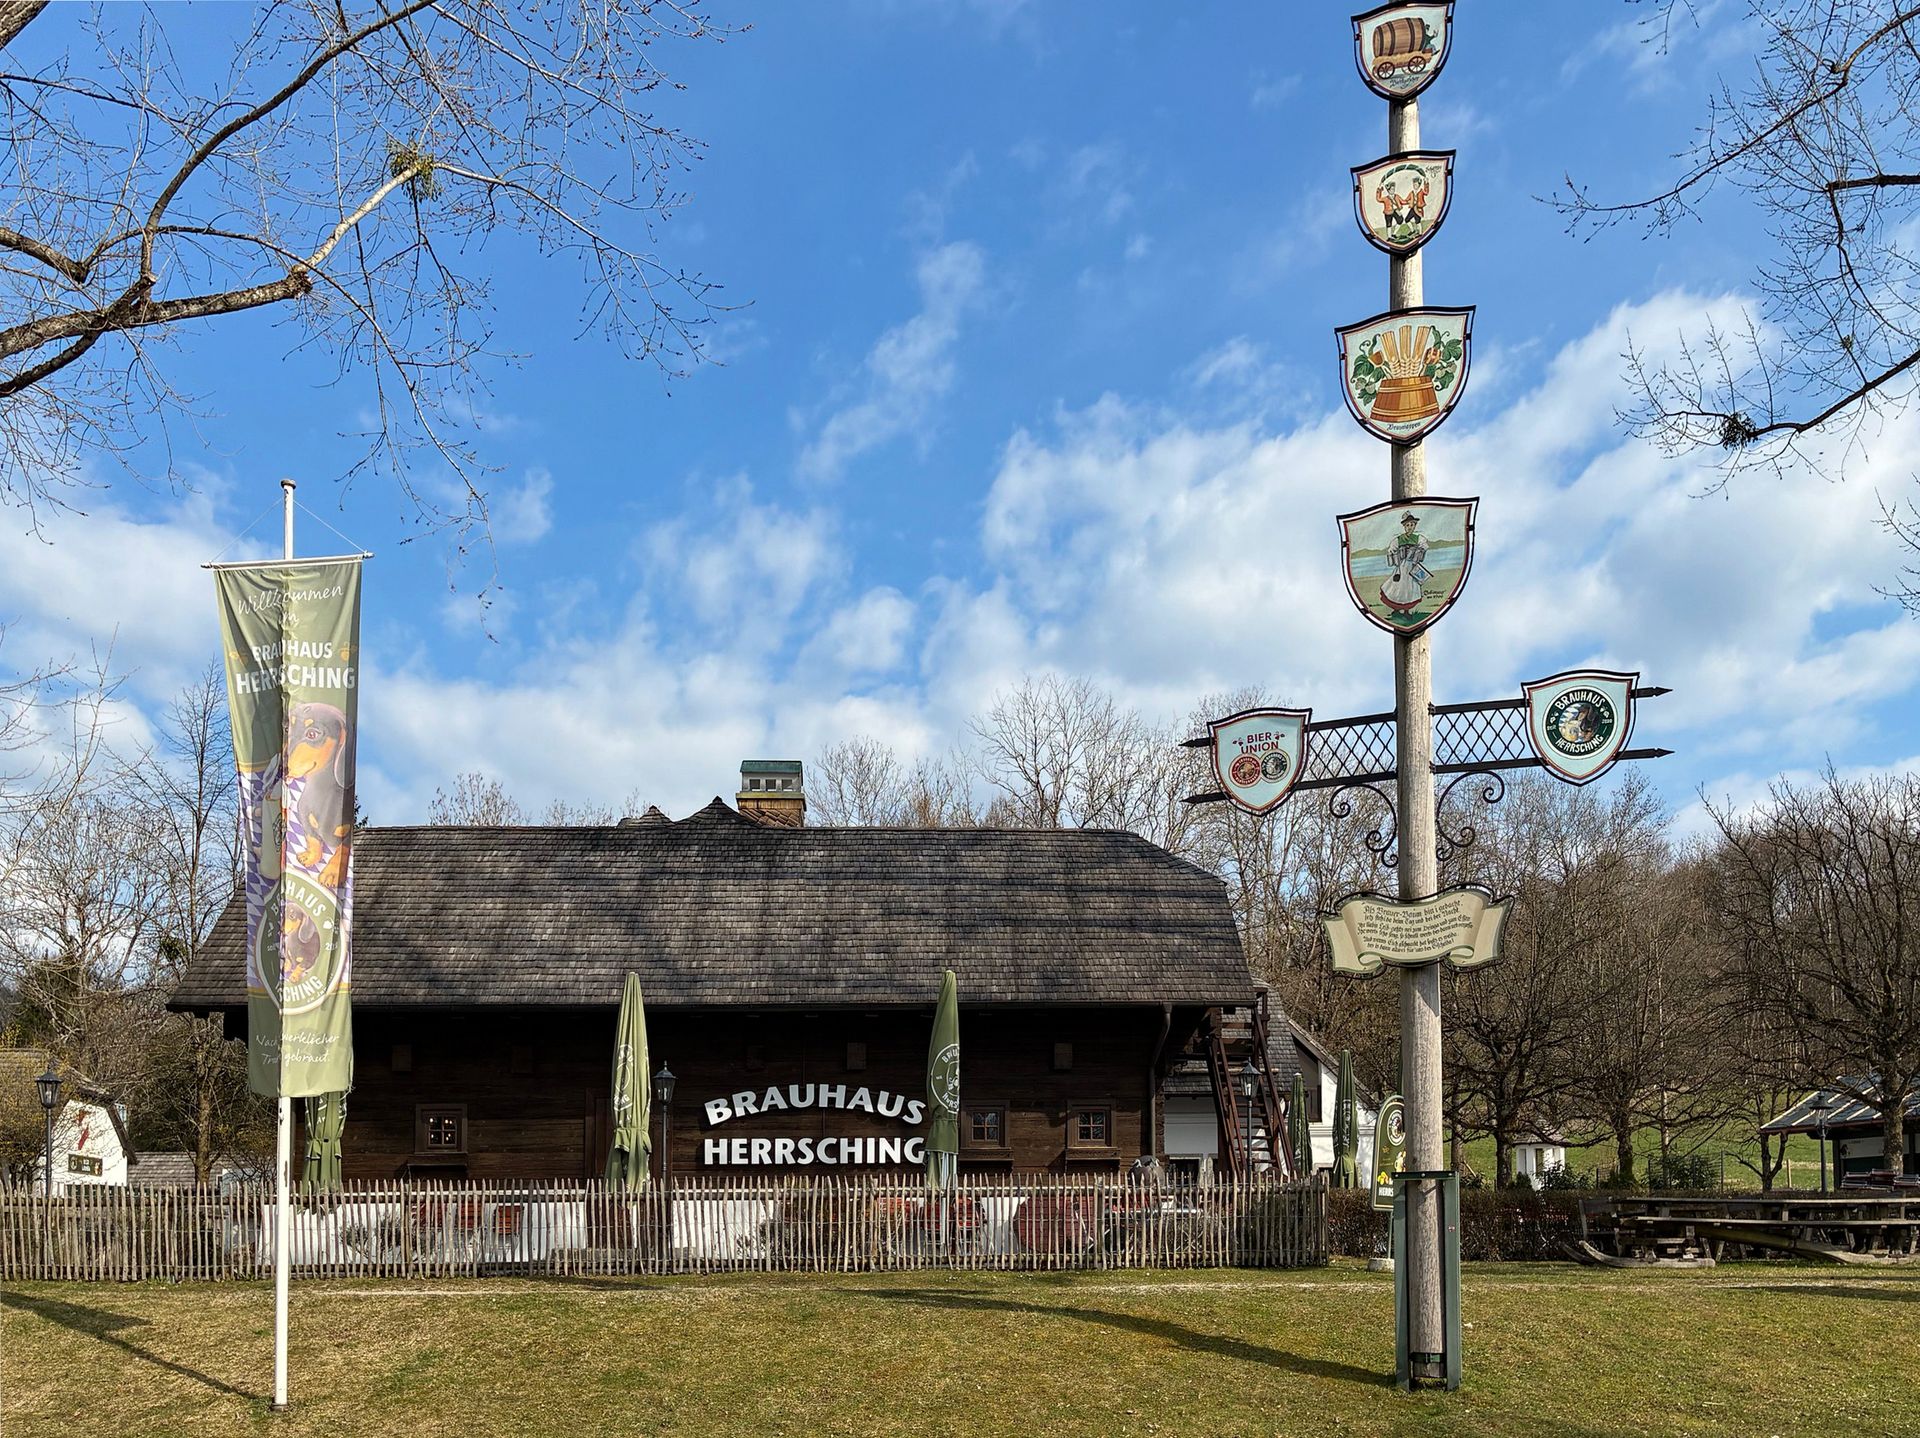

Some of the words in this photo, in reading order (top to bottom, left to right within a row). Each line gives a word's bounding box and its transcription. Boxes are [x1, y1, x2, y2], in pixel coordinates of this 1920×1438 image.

[238, 586, 343, 614] Willkommen
[252, 640, 333, 661] BRAUHAUS
[236, 664, 356, 694] HERRSCHING
[1555, 690, 1606, 711] BRAUHAUS
[1241, 741, 1279, 754] UNION
[1247, 731, 1272, 744] BIER
[1555, 734, 1604, 753] HERRSCHING
[704, 1083, 927, 1126] BRAUHAUS
[704, 1137, 925, 1165] HERRSCHING
[1378, 1186, 1394, 1197] HERRS
